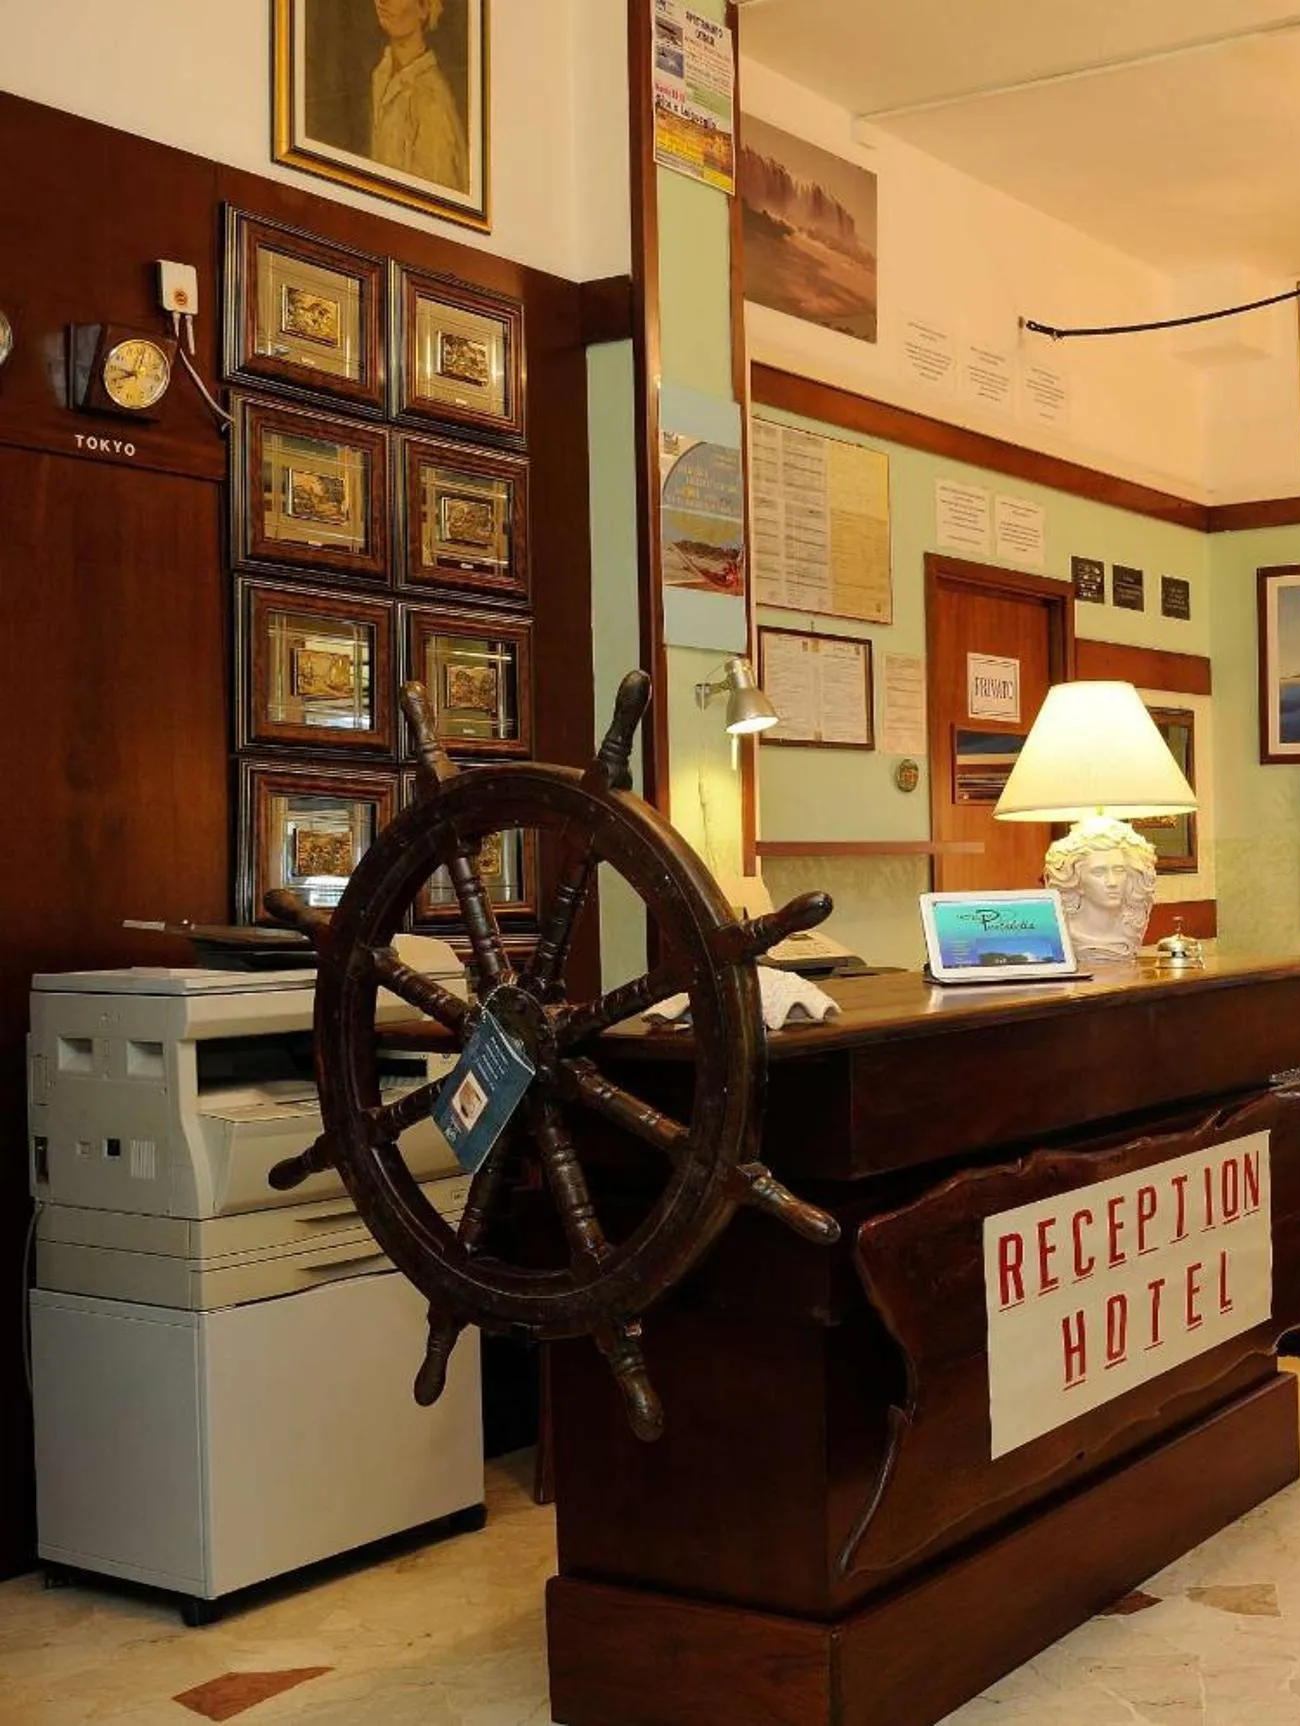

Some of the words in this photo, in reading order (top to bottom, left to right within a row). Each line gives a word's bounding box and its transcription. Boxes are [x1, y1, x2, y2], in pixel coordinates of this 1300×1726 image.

[74, 434, 136, 457] TOKYO
[998, 1150, 1261, 1311] RECEPTION
[1061, 1251, 1233, 1389] HOTEL
